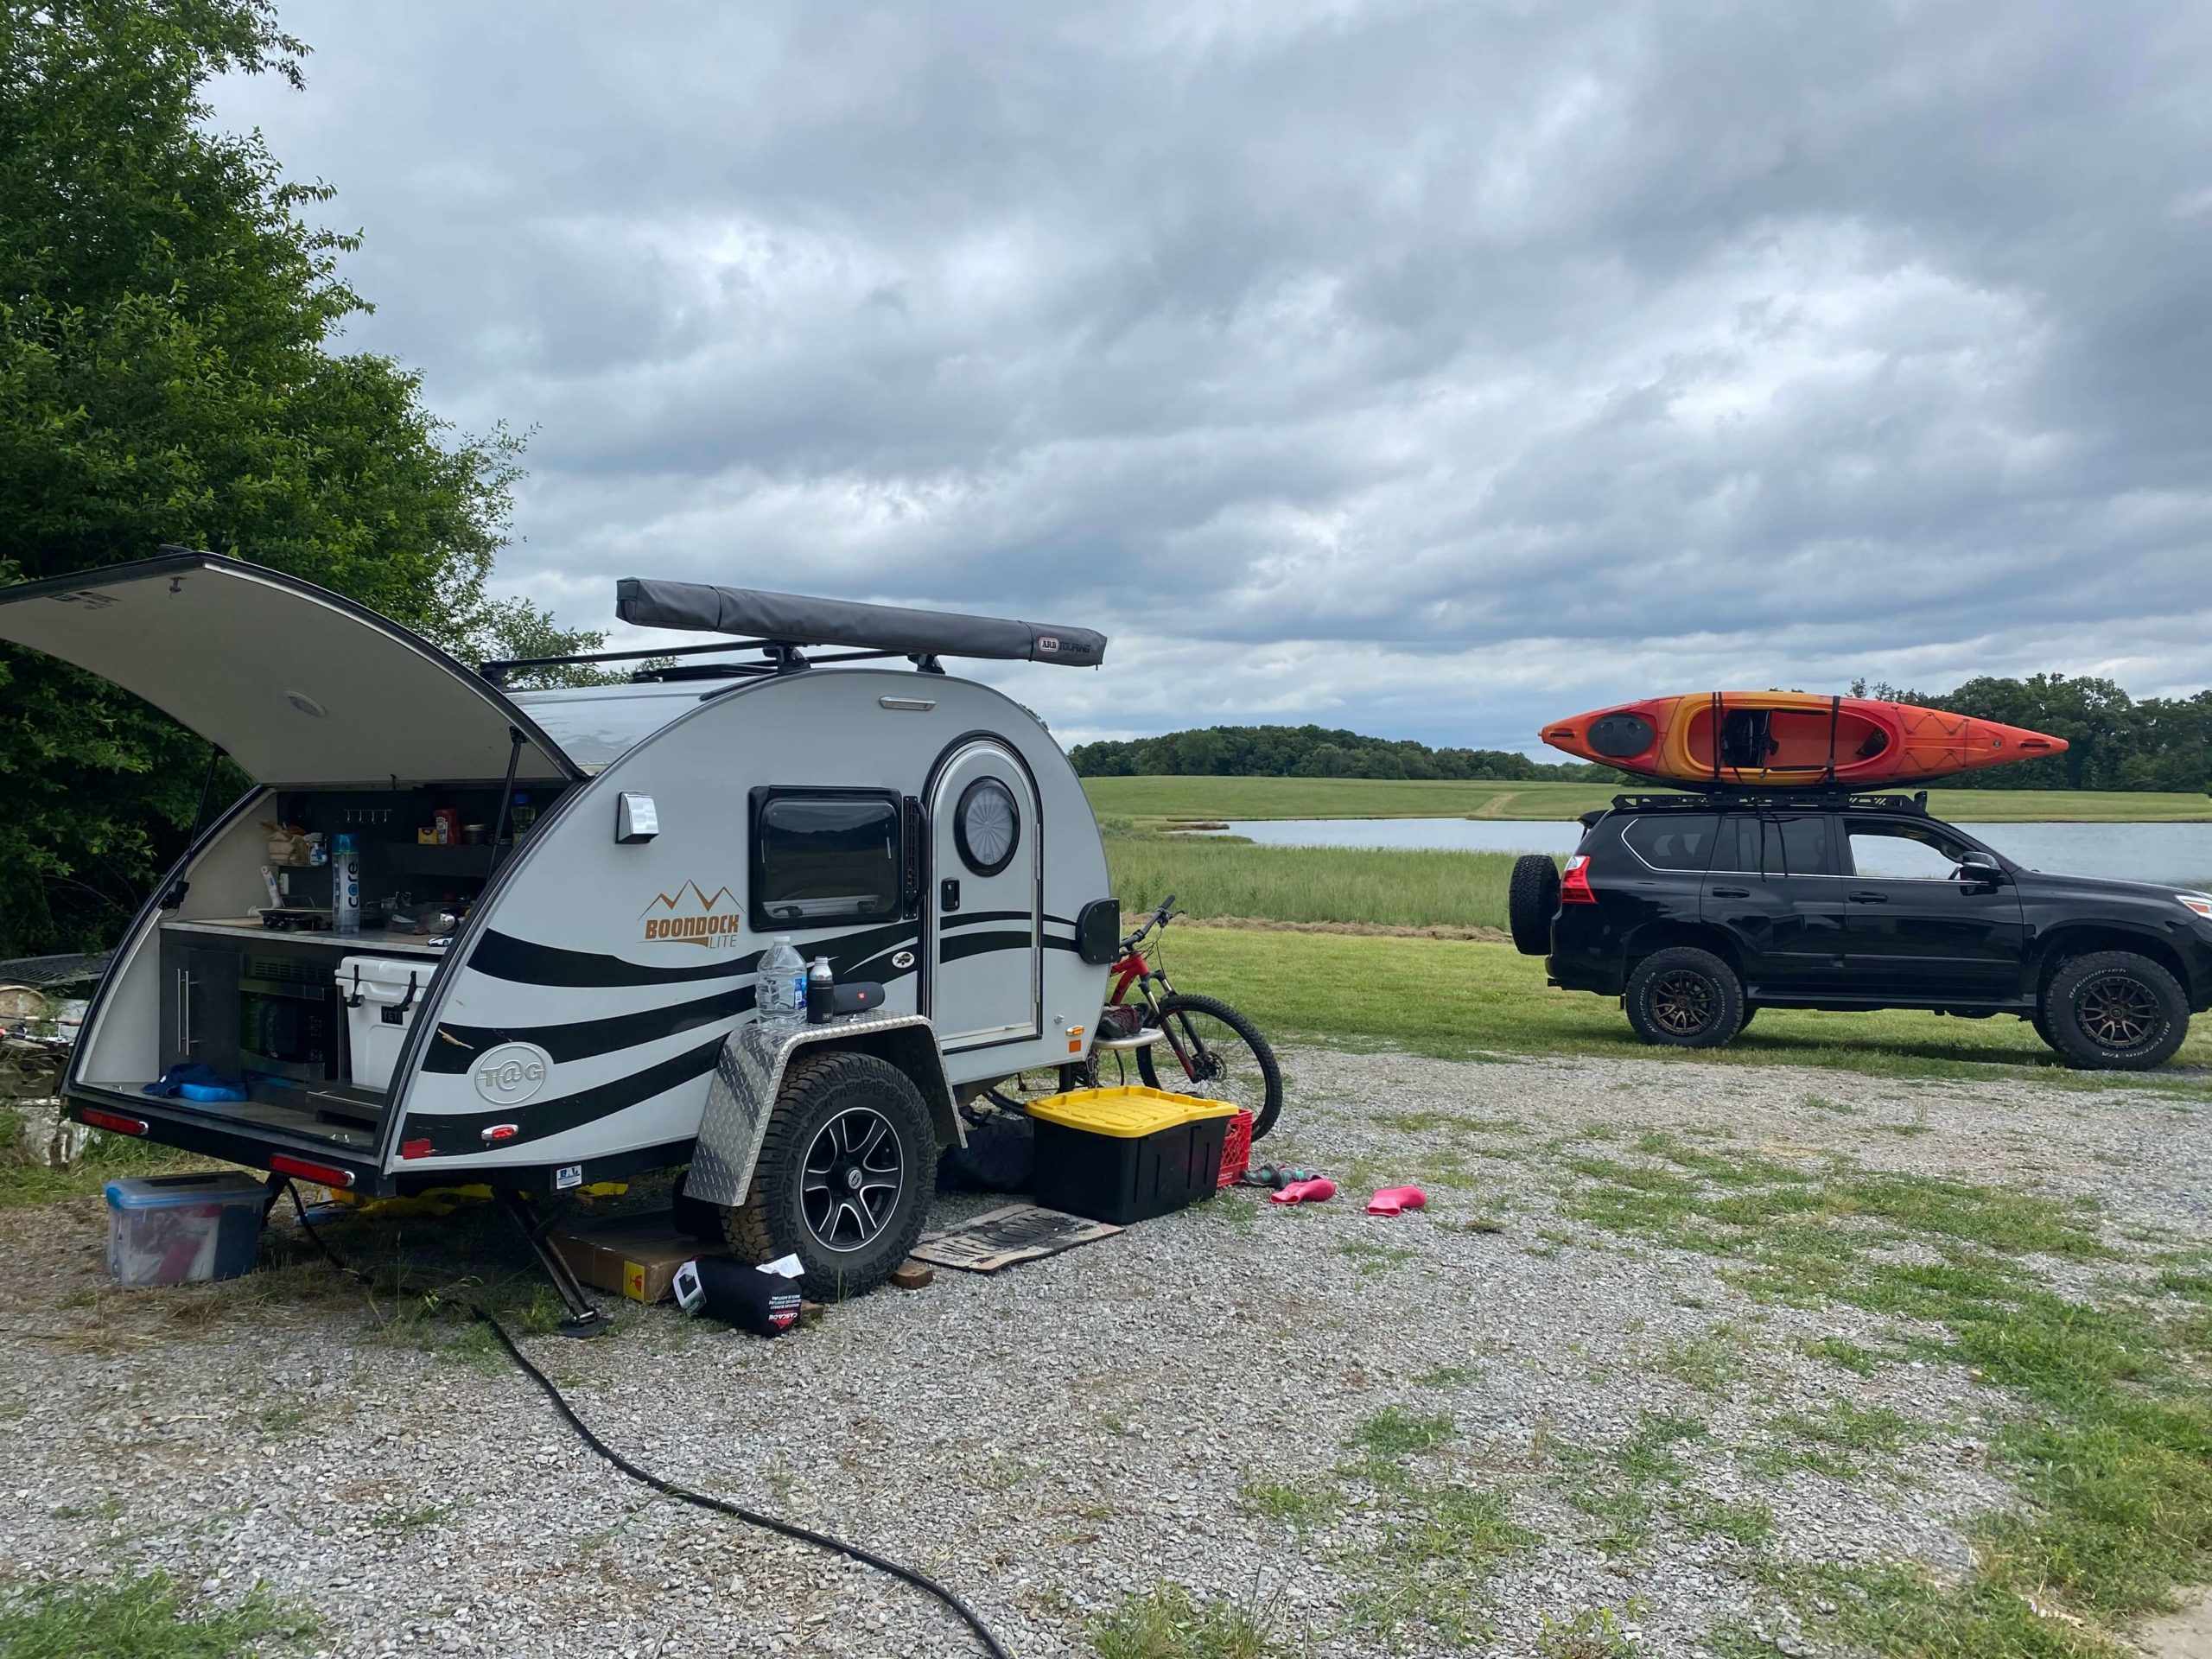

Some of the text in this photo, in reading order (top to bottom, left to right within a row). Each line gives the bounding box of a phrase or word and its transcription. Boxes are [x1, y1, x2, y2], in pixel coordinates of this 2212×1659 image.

[348, 862, 359, 908] core
[645, 914, 740, 940] BOONDOCK
[709, 934, 737, 950] LITE
